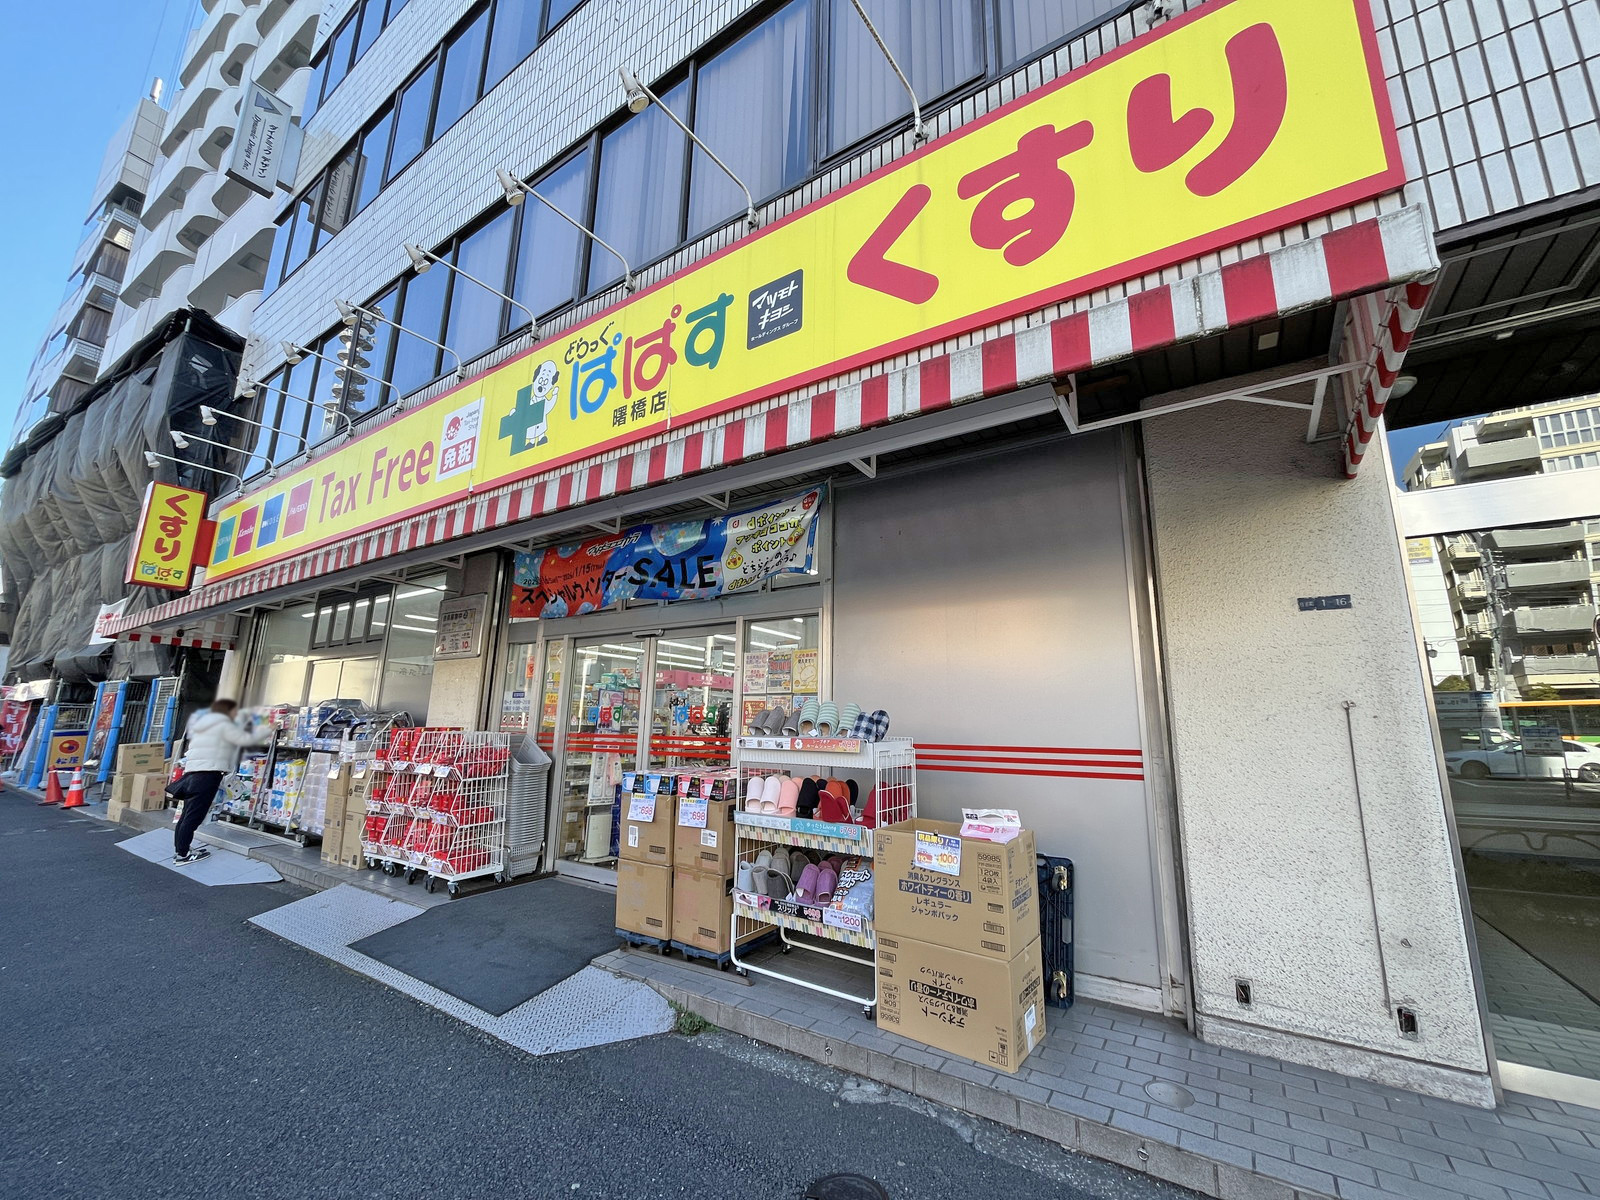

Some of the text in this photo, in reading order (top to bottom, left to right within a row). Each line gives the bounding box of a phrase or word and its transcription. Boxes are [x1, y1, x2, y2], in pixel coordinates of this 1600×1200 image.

[250, 114, 262, 139] Dynamic
[245, 138, 256, 159] Design
[847, 22, 1287, 305] くすり
[752, 280, 799, 310] マツモト
[758, 303, 794, 330] キヨシ
[564, 321, 615, 365] どらっぐ
[569, 292, 735, 421] ぱぱす
[612, 390, 668, 428] 曙橋店
[442, 440, 473, 470] 免税
[318, 440, 435, 524] Tax Free
[153, 493, 190, 562] くすり
[751, 537, 787, 554] ポイント
[141, 564, 184, 580] ぱぱす
[628, 555, 717, 589] SALE
[900, 880, 971, 903] ホワイトティーの香り
[907, 871, 961, 888] 消臭&フレグランス
[777, 904, 798, 915] スリッパ
[911, 905, 959, 922] ジャンボパック
[916, 896, 952, 909] レギュラー
[910, 981, 975, 1008] ホワイトティーの香り
[931, 978, 952, 990] ワイド
[918, 994, 969, 1018] 消臭&フレグランス
[921, 1006, 966, 1029] デオシート
